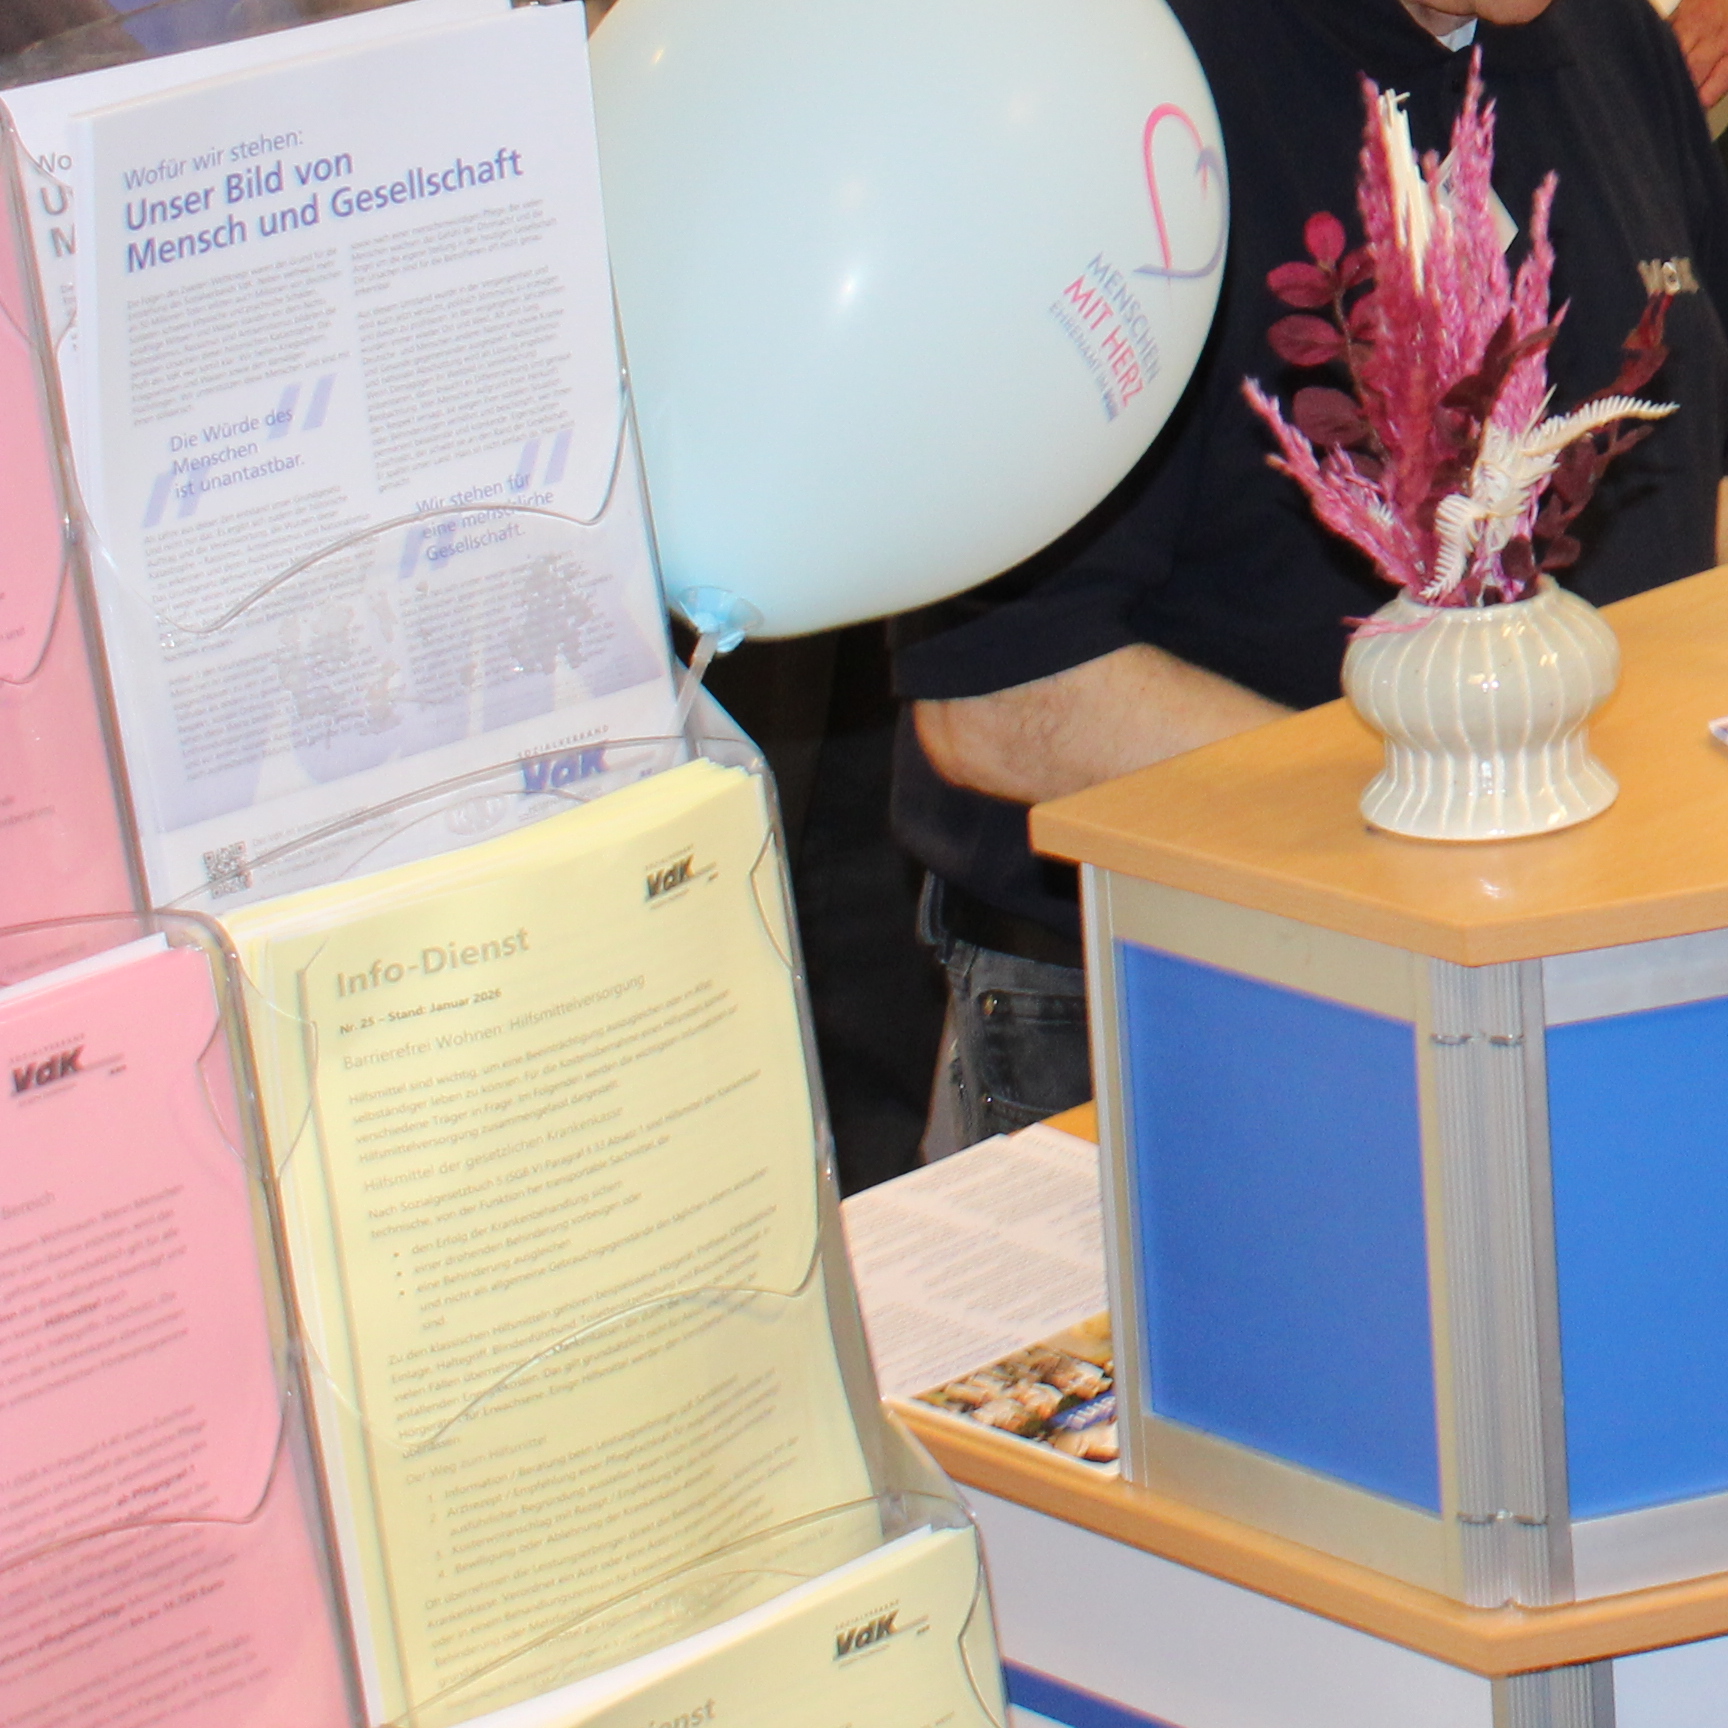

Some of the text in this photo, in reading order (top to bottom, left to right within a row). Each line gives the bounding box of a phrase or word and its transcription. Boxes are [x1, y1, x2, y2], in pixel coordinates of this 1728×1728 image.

[123, 129, 305, 190] Wofür wir stehen:
[125, 151, 354, 231] Unser Bild von
[126, 145, 525, 273] Mensch und Gesellschaft
[1063, 274, 1145, 408] MIT HERZ
[1086, 250, 1162, 384] MENSCHEN
[169, 407, 294, 453] Die Würde des
[171, 439, 260, 476] Menschen
[174, 452, 306, 500] ist unantastbar.
[415, 472, 532, 514] Wir stehen für
[421, 518, 458, 540] eine
[425, 520, 527, 561] Gesellschaft.
[522, 747, 611, 794] VdK
[645, 855, 694, 901] VdK
[337, 927, 531, 999] Info-Dienst
[339, 1020, 357, 1035] Nr.
[360, 1016, 376, 1029] 25
[388, 1004, 427, 1022] Stand:
[429, 996, 471, 1015] Januar
[473, 987, 502, 1004] 2026
[343, 975, 646, 1071] Barrierefrei Wohnen: Hilfsmittelversorgung
[11, 1045, 84, 1095] VdK
[364, 1164, 435, 1193] Hilfsmittel
[438, 1159, 463, 1176] der
[464, 1133, 544, 1170] gesetzlichen
[368, 1204, 398, 1221] Nach
[400, 1176, 495, 1214] Sozialgesetzbuch
[479, 1188, 526, 1211] Funktion
[834, 1609, 899, 1657] VdK
